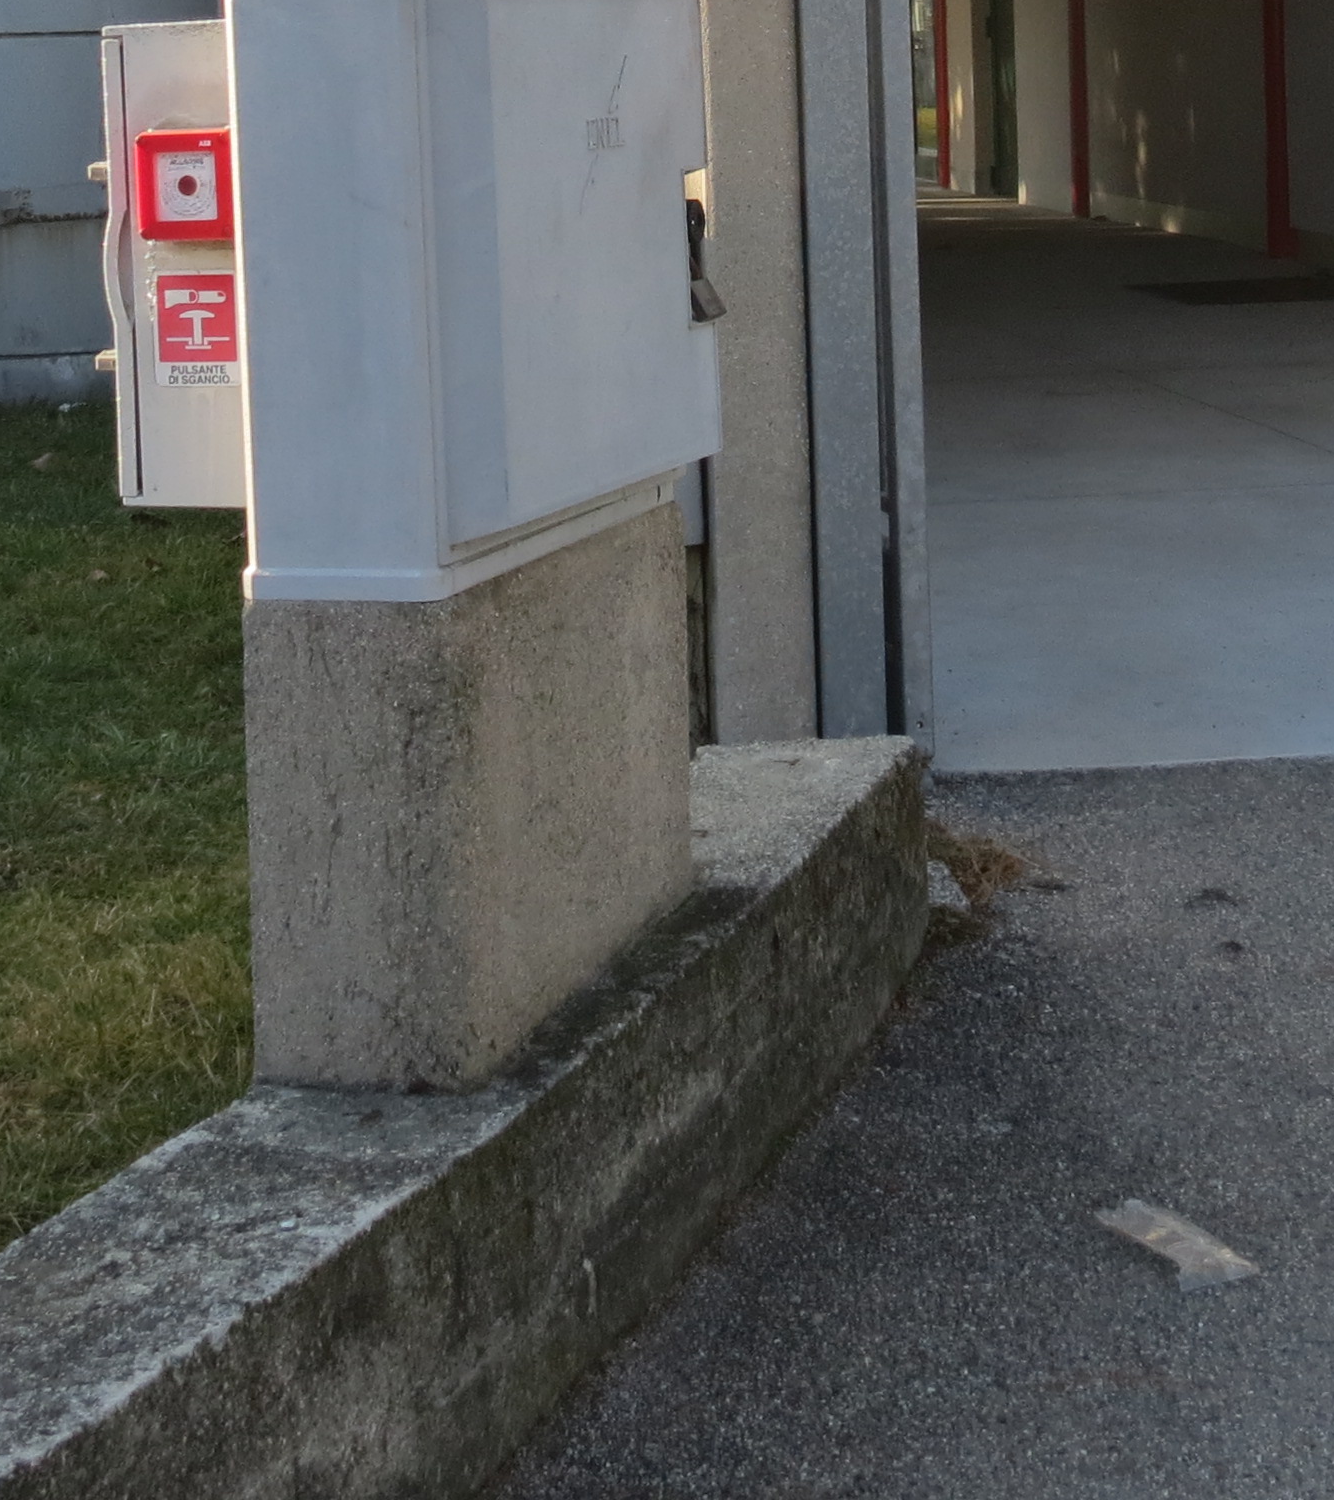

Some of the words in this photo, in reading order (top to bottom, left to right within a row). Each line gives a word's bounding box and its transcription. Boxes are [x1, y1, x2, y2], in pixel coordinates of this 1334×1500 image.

[170, 364, 227, 375] PULSANTE
[168, 375, 179, 385] DI
[181, 374, 231, 385] SGANCIO
